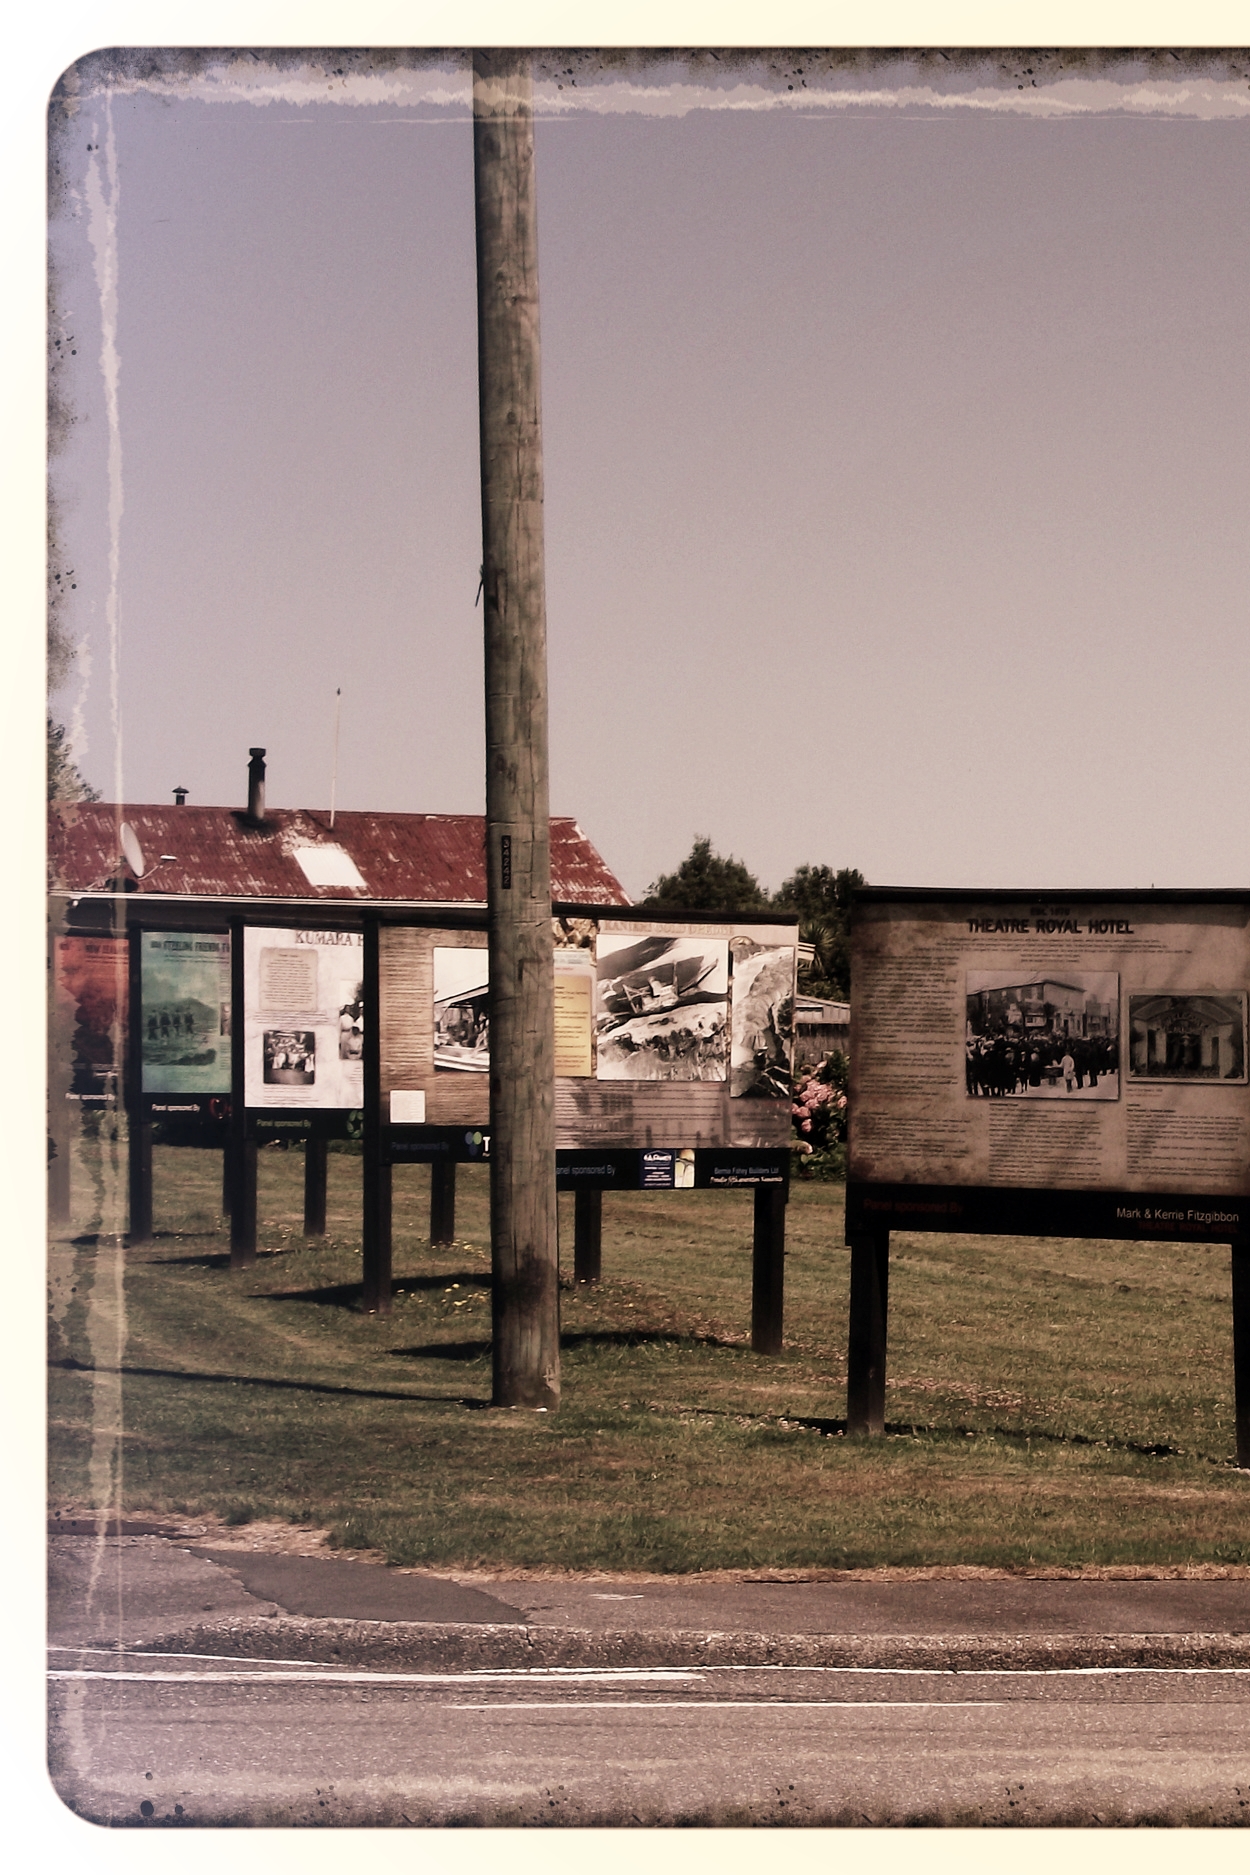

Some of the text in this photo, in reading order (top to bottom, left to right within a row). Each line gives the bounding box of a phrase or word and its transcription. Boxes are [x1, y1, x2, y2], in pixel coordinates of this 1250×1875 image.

[967, 918, 1134, 934] THEATRE ROYAL HOTEL
[295, 931, 353, 946] KUMARA
[556, 1164, 616, 1177] anel sponsored By
[1116, 1207, 1240, 1224] Mark & Kerrie Fitzgibbon
